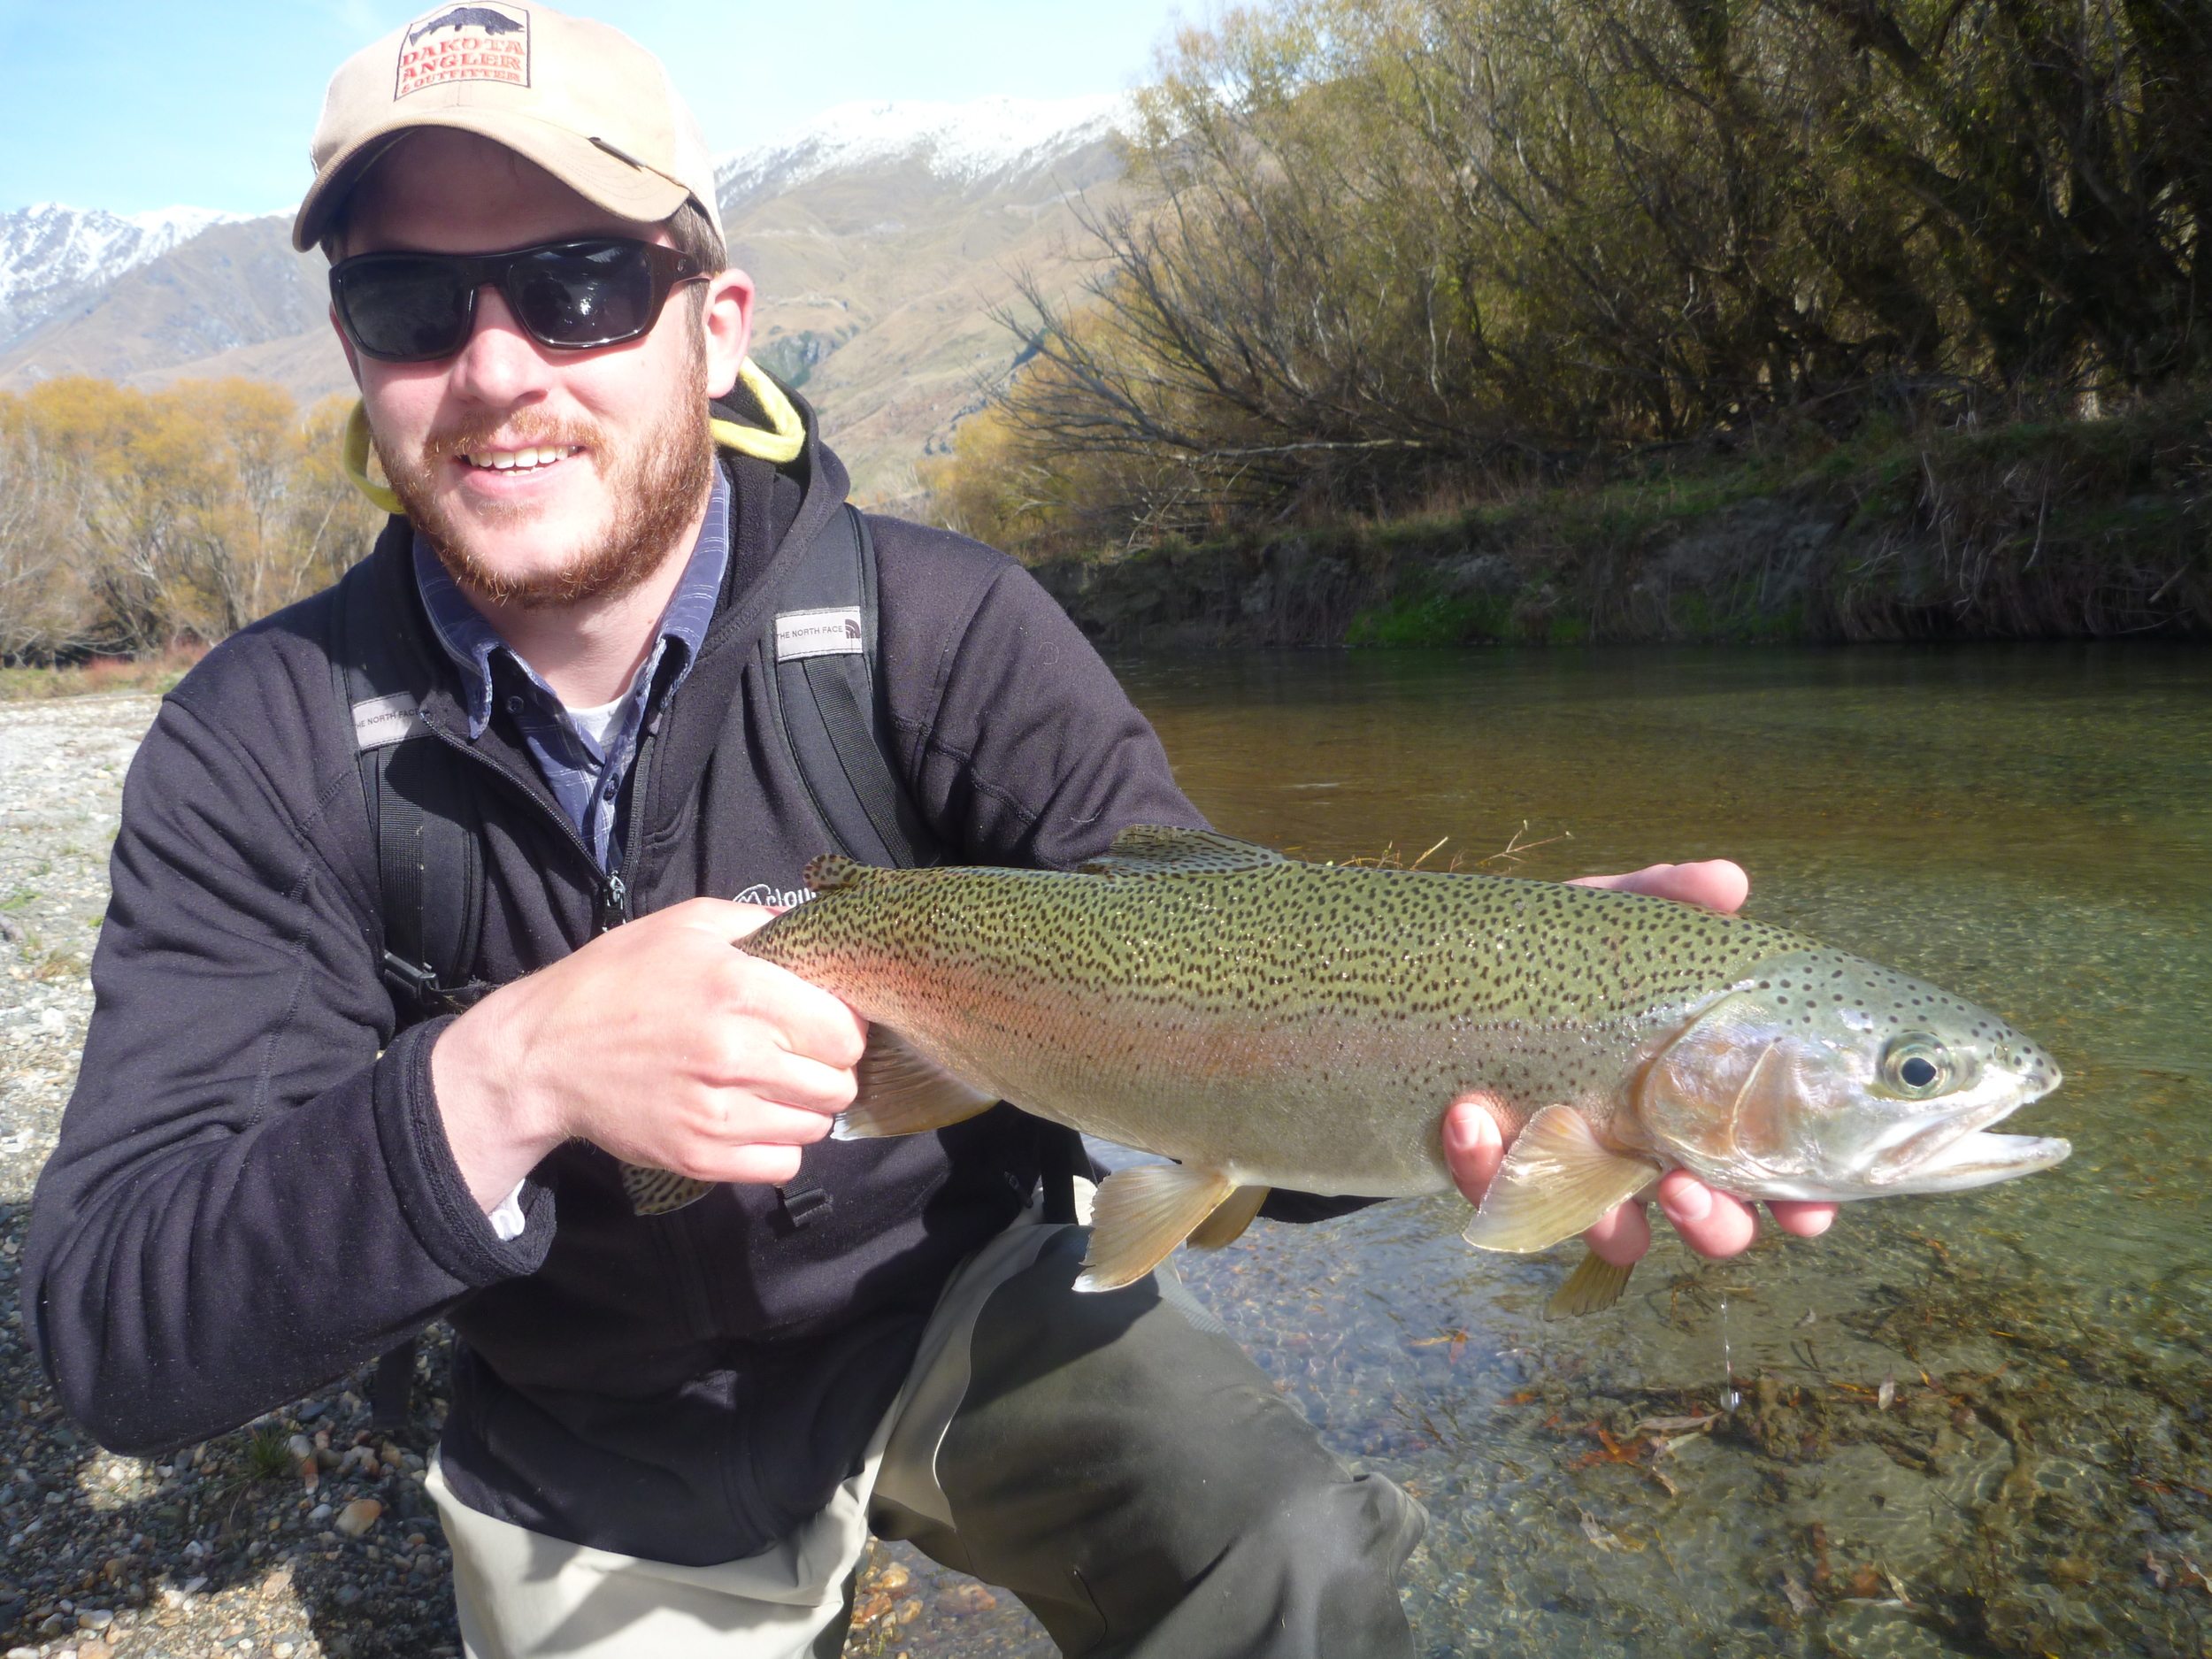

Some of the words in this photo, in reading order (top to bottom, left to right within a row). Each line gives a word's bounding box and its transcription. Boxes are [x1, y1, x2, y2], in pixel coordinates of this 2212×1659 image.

[400, 37, 526, 68] DAKOTA
[403, 52, 523, 83] ANGLER
[401, 83, 411, 94] &
[413, 69, 521, 88] OUTFITTER
[792, 627, 820, 638] NORTH
[822, 626, 843, 634] FACE
[367, 711, 396, 726] NORTH
